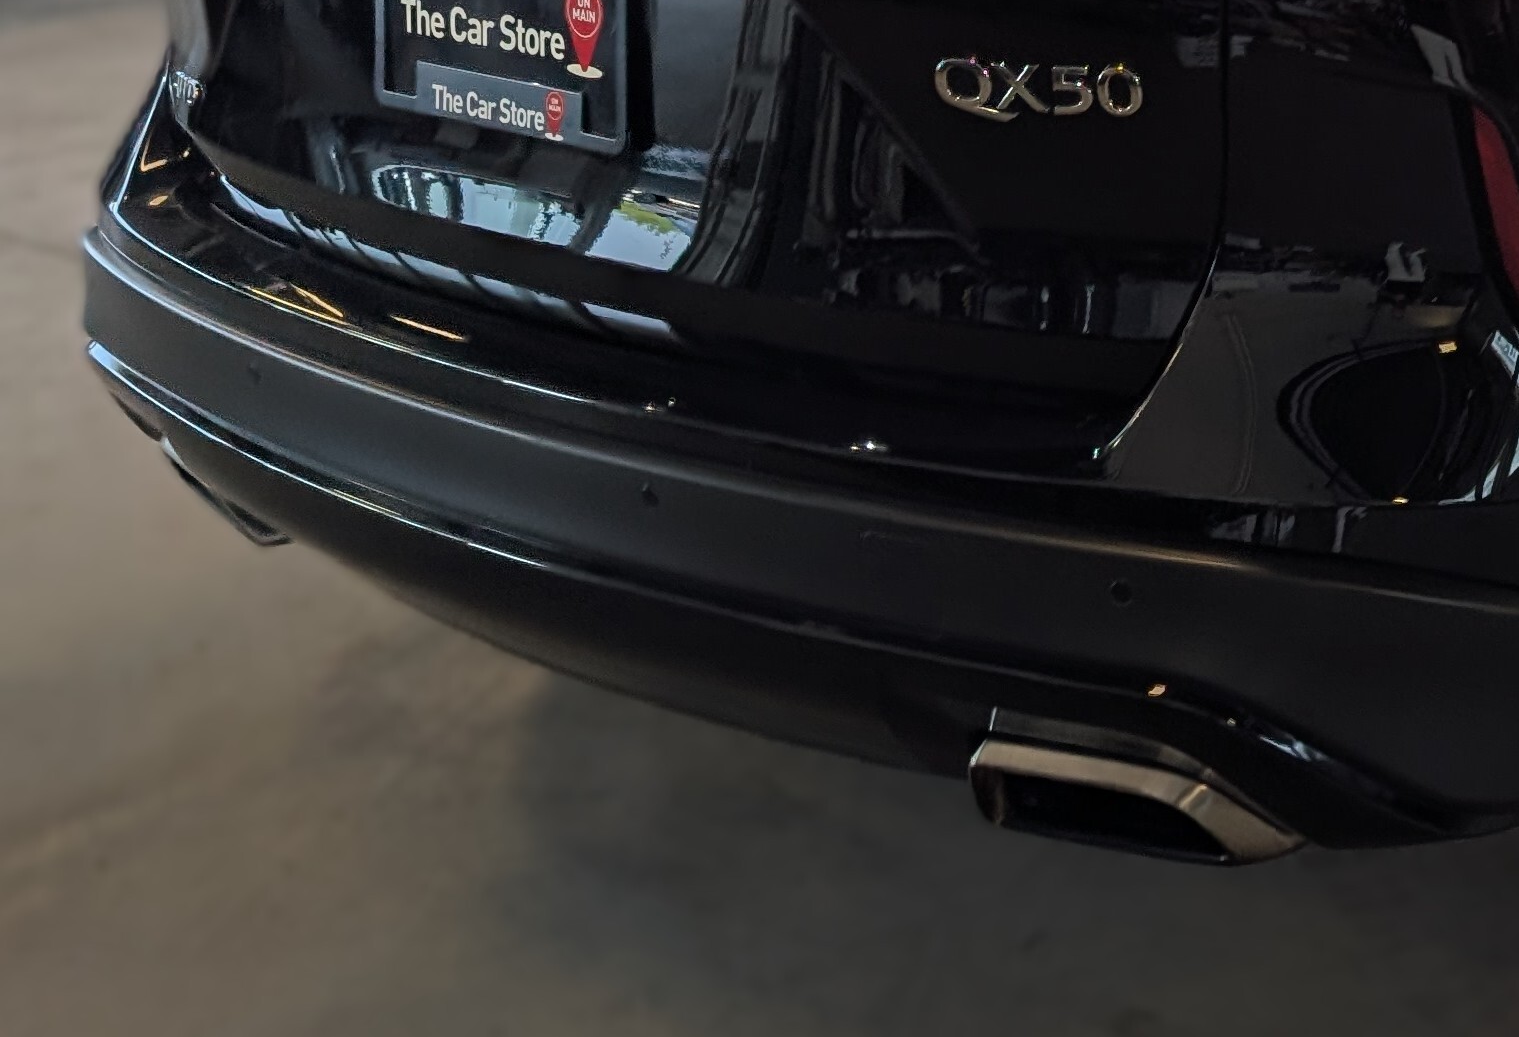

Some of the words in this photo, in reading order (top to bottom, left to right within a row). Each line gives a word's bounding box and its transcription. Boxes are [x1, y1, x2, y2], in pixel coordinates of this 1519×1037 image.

[450, 6, 495, 47] Car
[499, 14, 566, 60] Store
[572, 8, 596, 24] MAIN
[431, 83, 464, 114] The
[466, 91, 497, 121] Car
[499, 98, 545, 131] Store
[934, 57, 1144, 123] QX50
